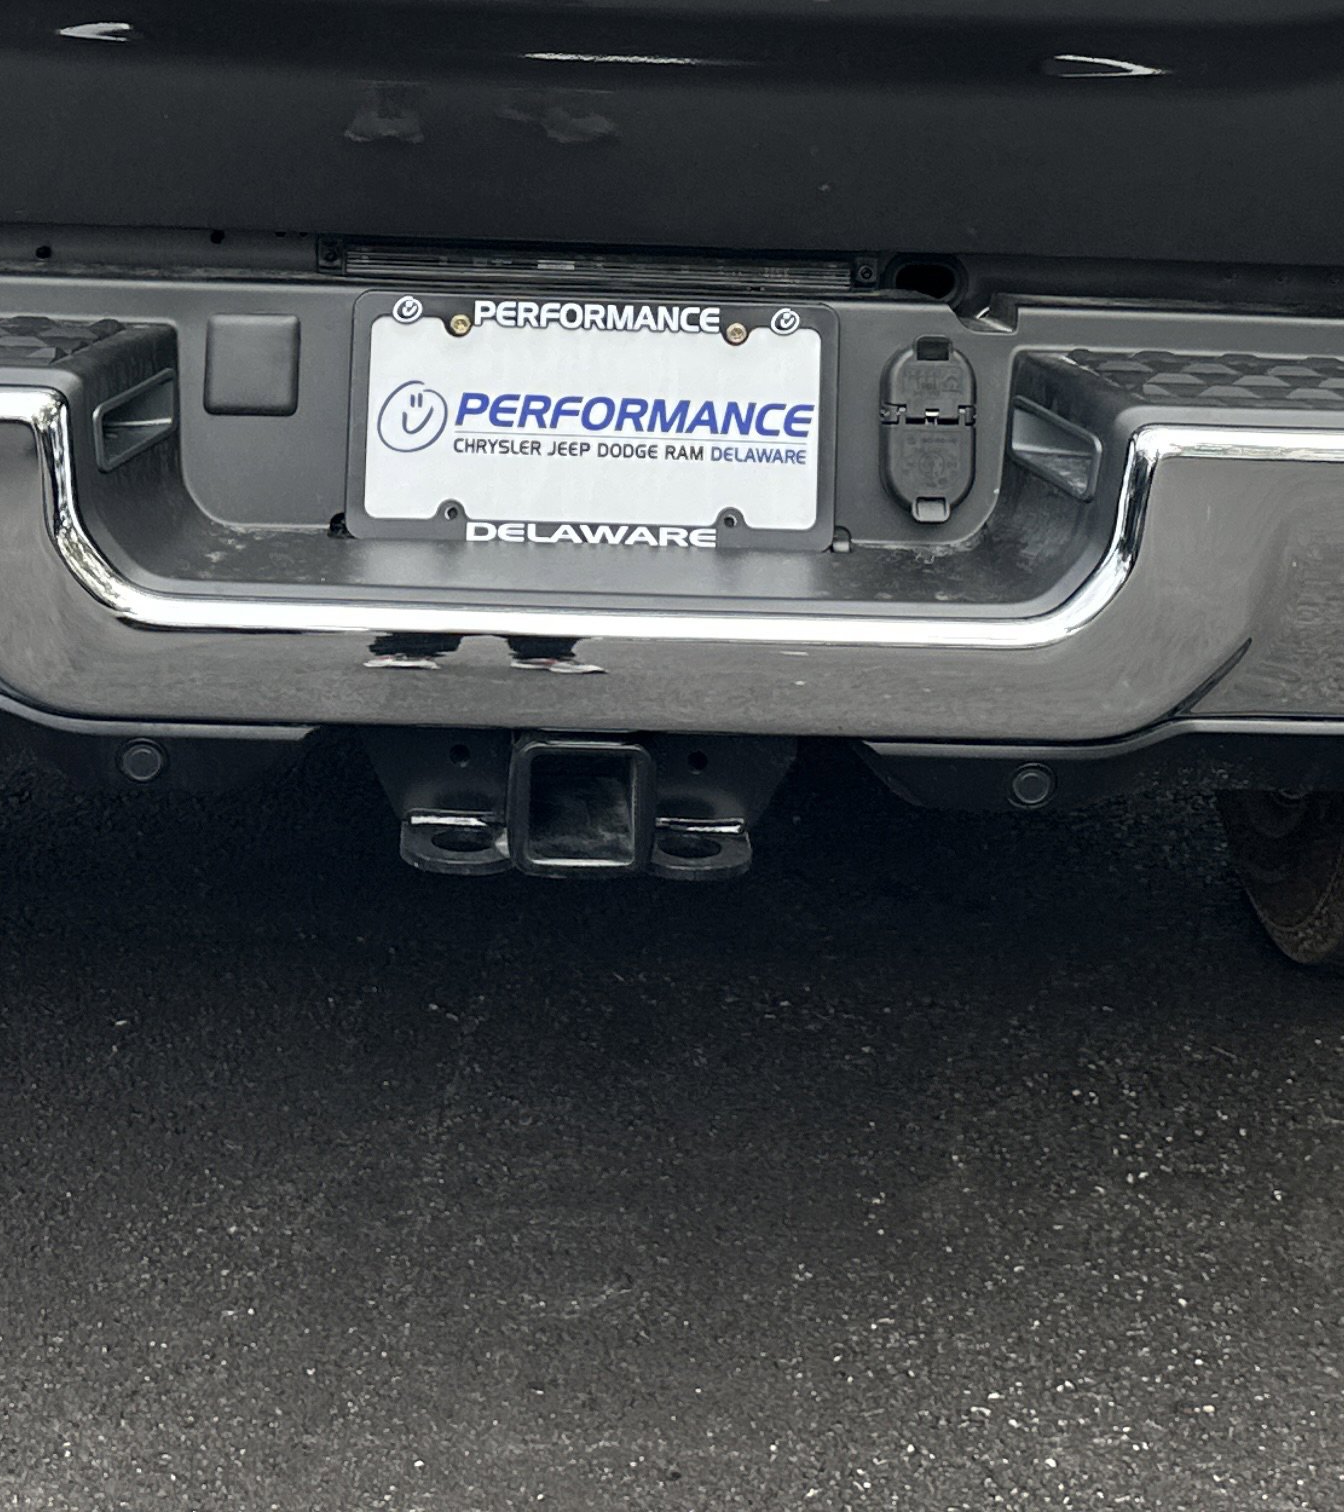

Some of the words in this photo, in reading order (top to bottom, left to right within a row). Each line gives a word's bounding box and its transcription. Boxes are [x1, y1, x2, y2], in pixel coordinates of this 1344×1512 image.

[472, 299, 721, 335] PERFORMANCE
[454, 391, 816, 439] PERFORMANCE
[453, 437, 543, 457] CHRYSLER
[547, 440, 591, 458] JEEP
[596, 441, 659, 460] DODGE
[664, 445, 705, 462] RAM
[710, 446, 807, 465] DELAWARE
[465, 521, 718, 549] DELAWARE
